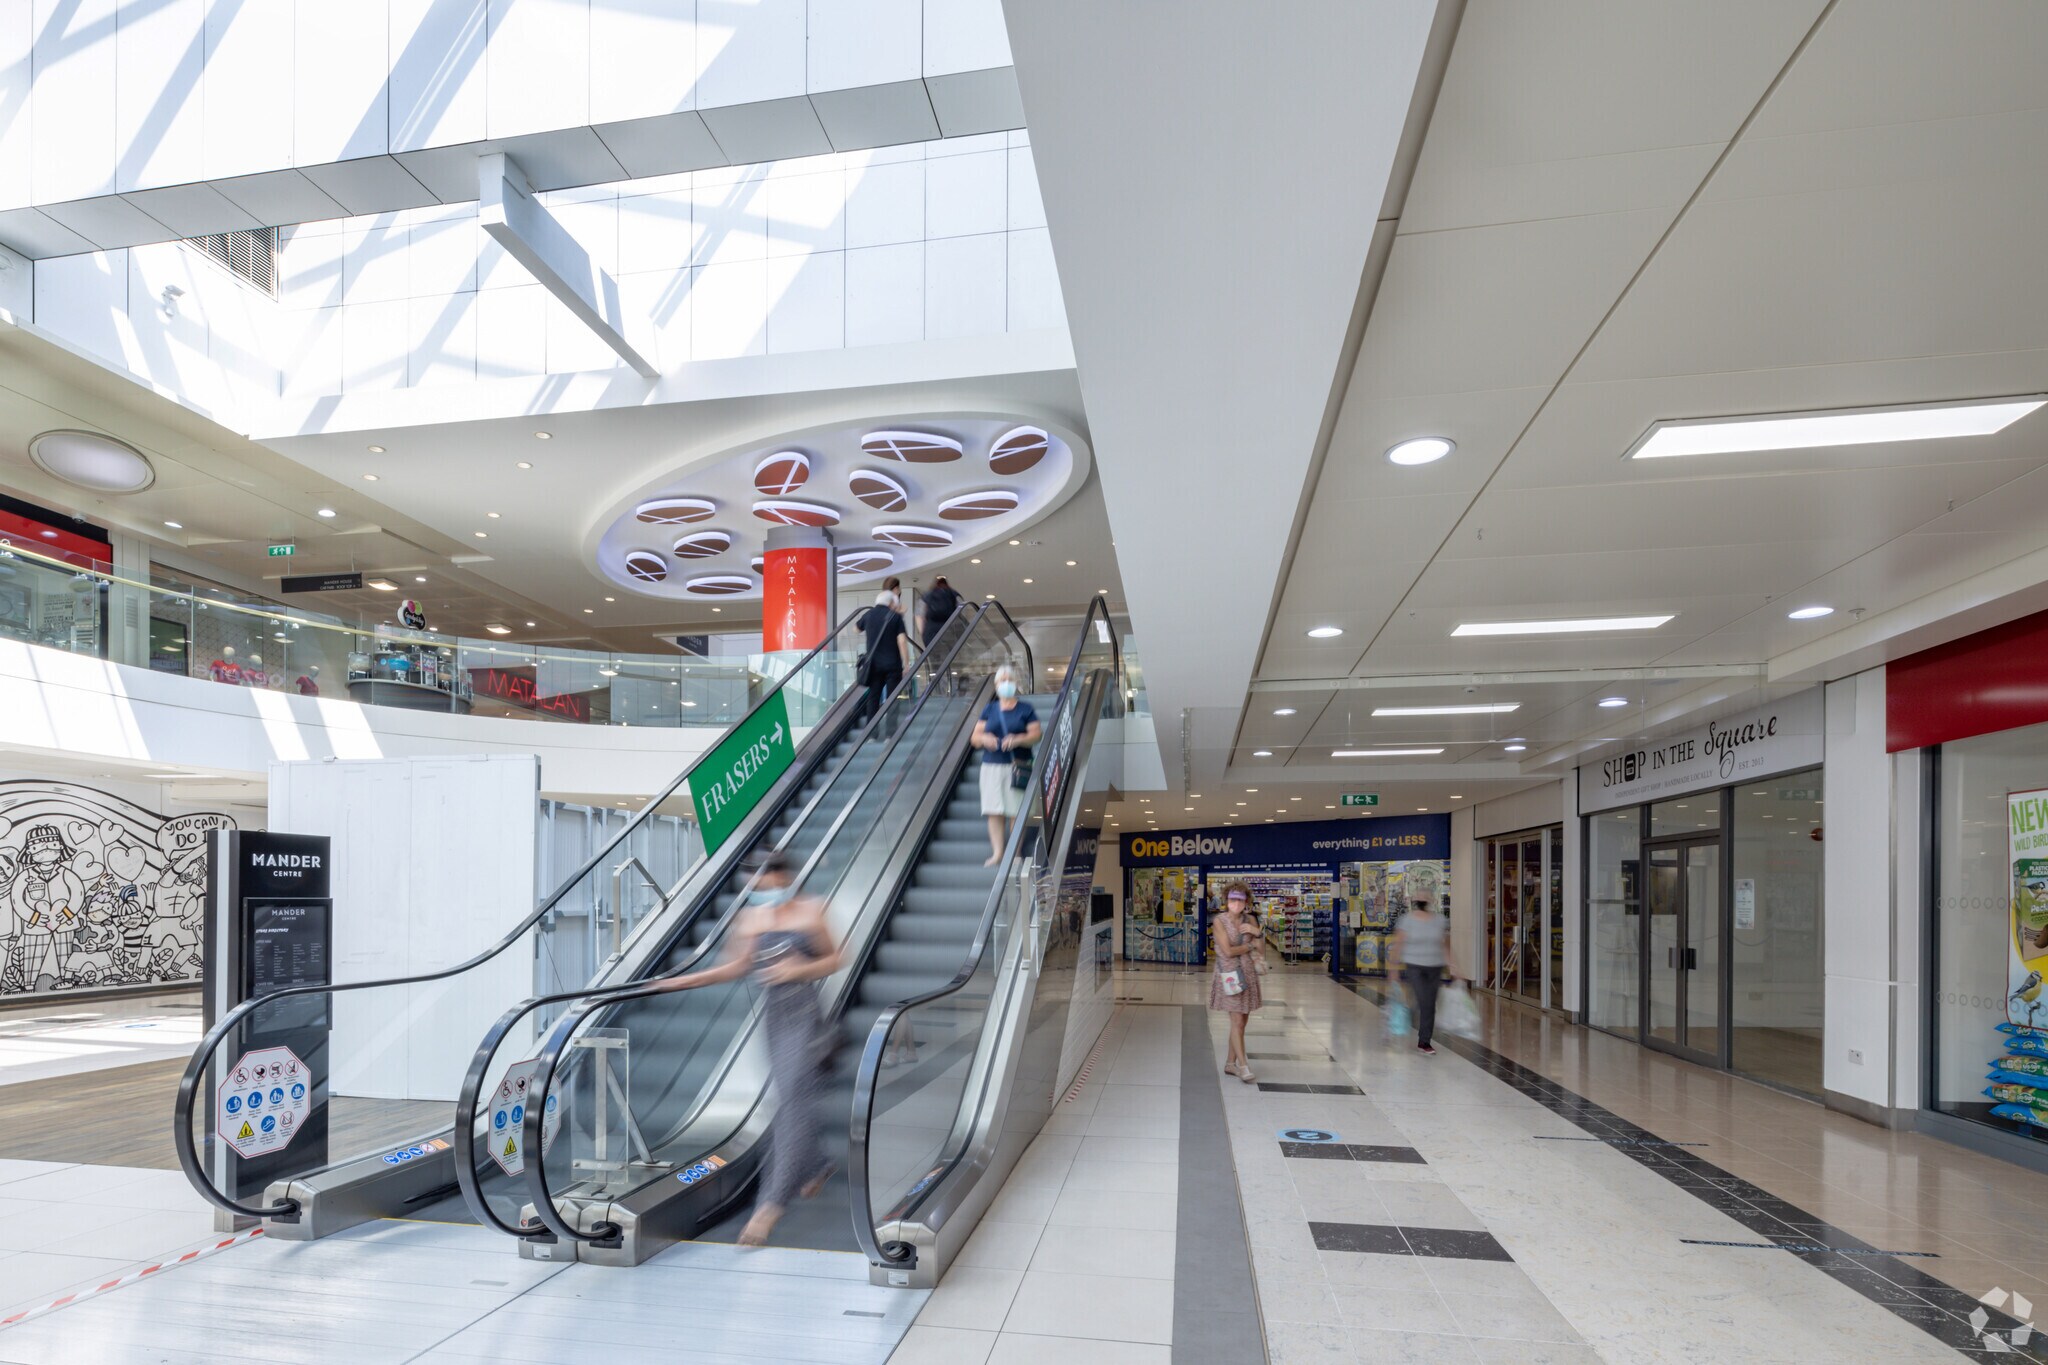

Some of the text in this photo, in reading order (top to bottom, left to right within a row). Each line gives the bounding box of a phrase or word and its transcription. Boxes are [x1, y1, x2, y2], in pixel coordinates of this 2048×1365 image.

[787, 555, 797, 627] MATALAN
[488, 668, 580, 718] MATALAN
[1653, 748, 1666, 770] IN
[1670, 740, 1695, 765] THE
[1704, 716, 1778, 780] Square
[701, 734, 770, 824] FRASERS
[1690, 769, 1714, 782] LOCALLY
[2011, 798, 2048, 836] NEW
[164, 816, 219, 836] YOU CAN
[175, 833, 197, 848] DO
[1312, 835, 1426, 850] everything £1 or LESS
[2013, 837, 2031, 852] WILD
[252, 853, 321, 868] MANDER
[273, 870, 302, 878] CENTRE
[271, 908, 306, 916] MANDER
